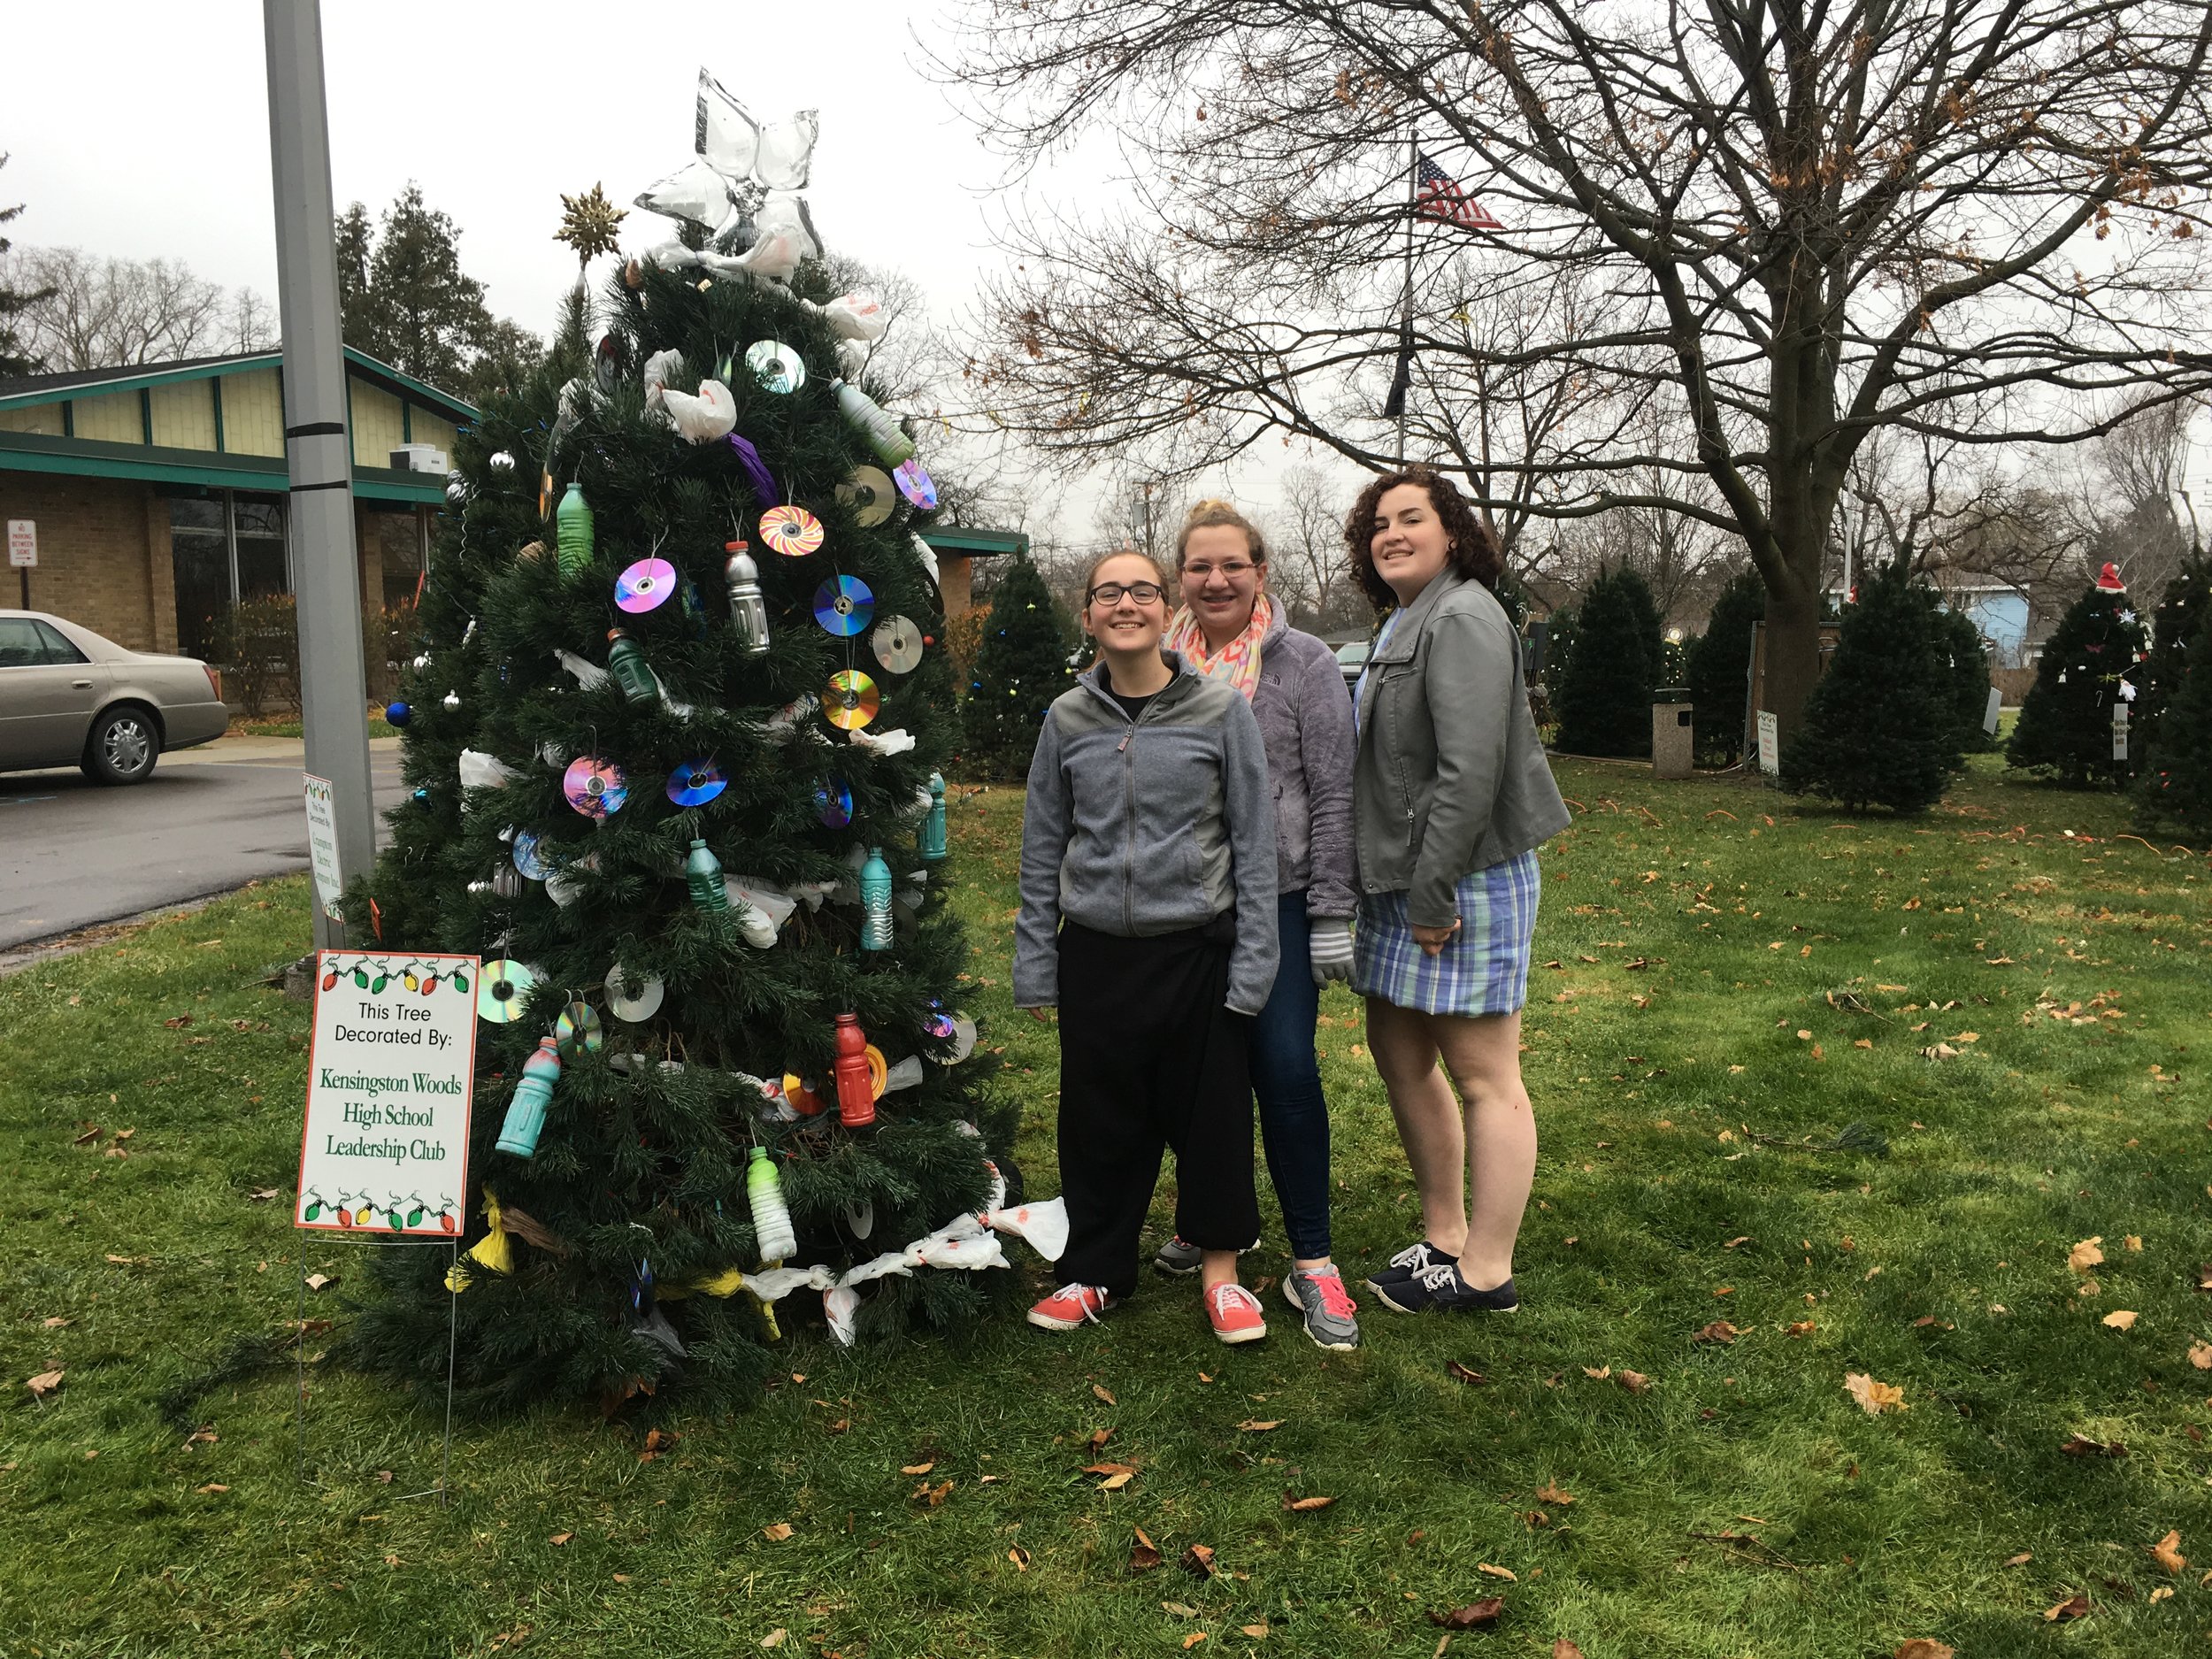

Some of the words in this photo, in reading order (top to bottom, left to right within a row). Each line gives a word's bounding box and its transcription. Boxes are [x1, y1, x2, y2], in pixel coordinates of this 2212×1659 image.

[358, 1002, 389, 1020] This
[396, 1003, 432, 1022] Tree
[335, 1024, 422, 1045] Decorated
[428, 1028, 452, 1051] By:
[319, 1067, 410, 1098] Kensingston
[411, 1072, 463, 1095] Woods
[342, 1102, 382, 1131] High
[384, 1103, 434, 1127] School
[325, 1134, 407, 1166] Leadership
[410, 1139, 446, 1161] Club
